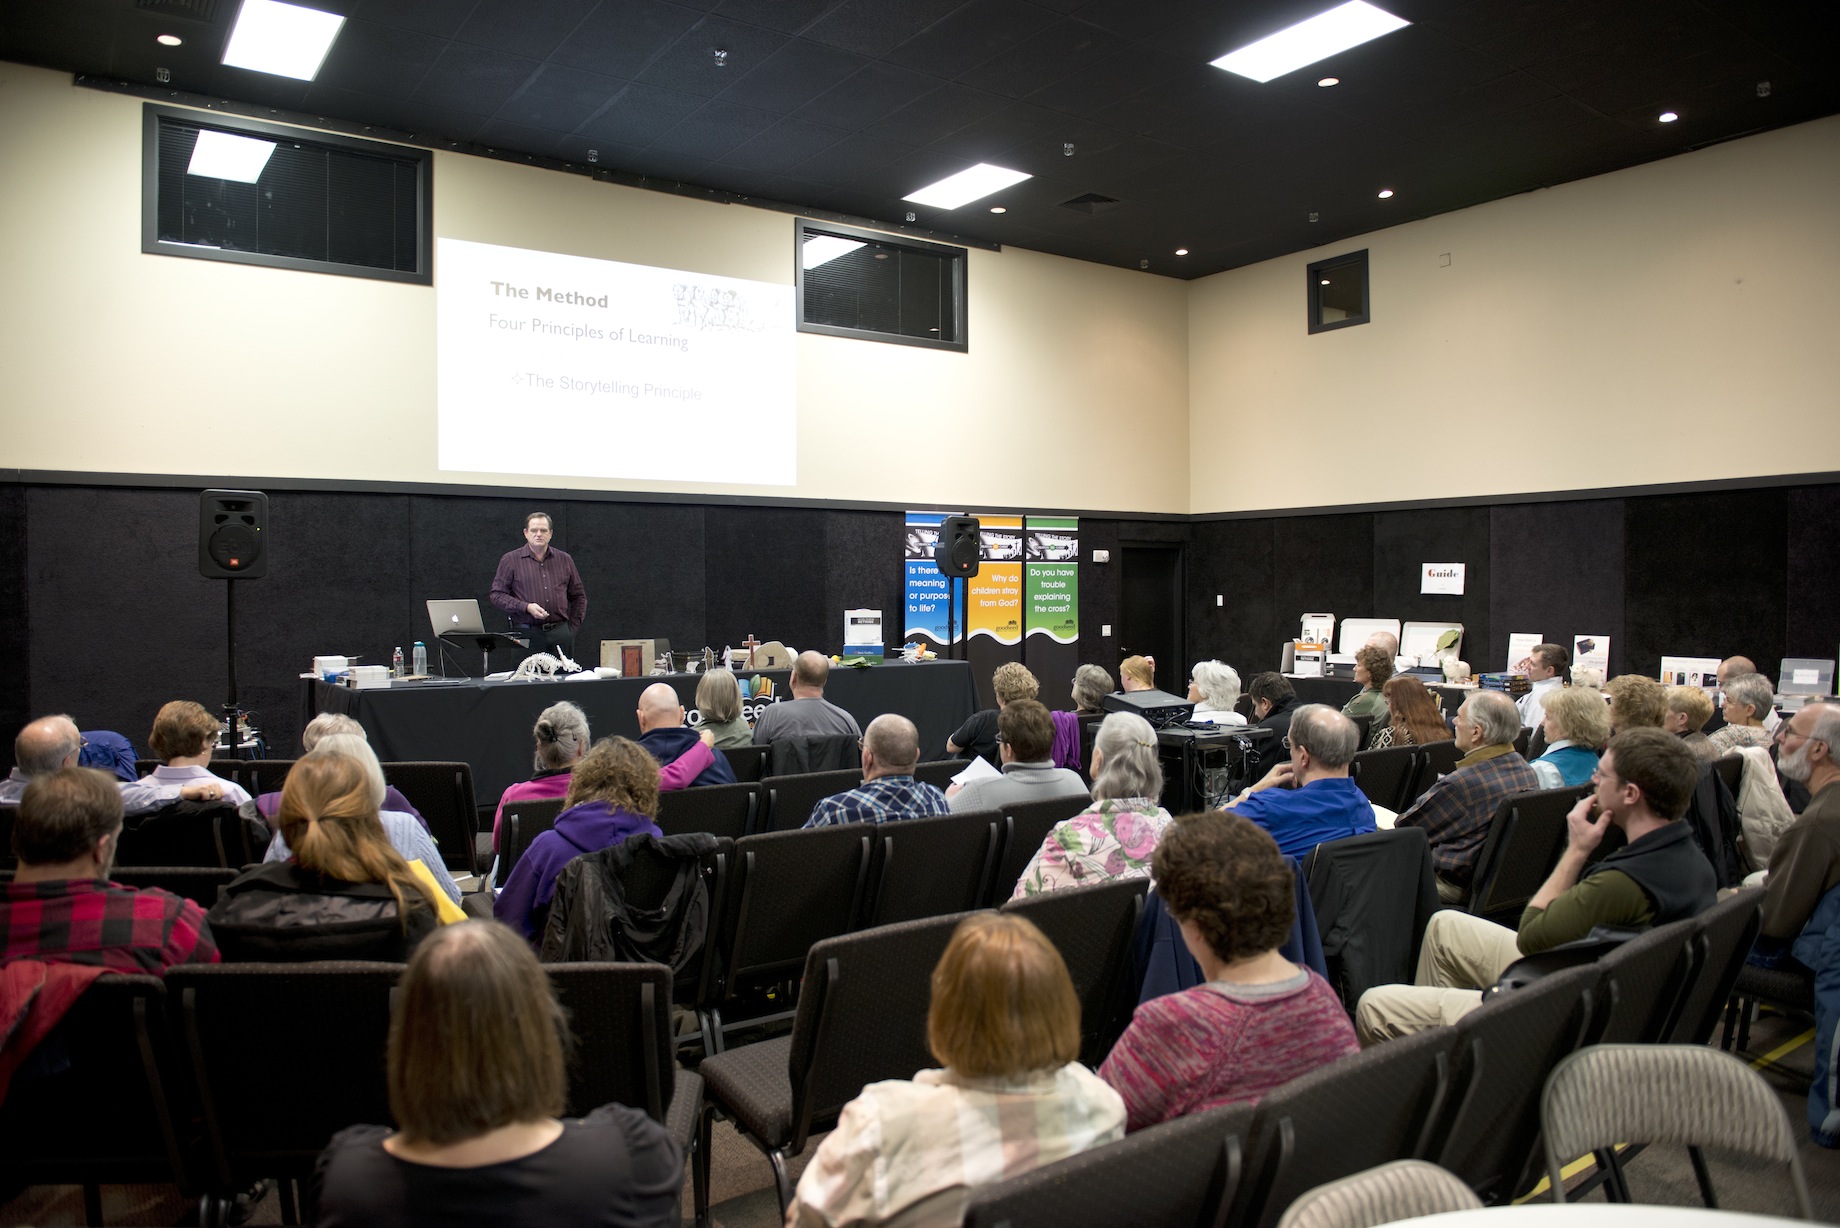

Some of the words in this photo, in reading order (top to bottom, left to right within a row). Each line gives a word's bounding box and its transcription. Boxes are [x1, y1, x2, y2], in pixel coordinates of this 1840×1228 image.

[490, 281, 529, 299] The
[536, 286, 608, 308] Method
[489, 313, 526, 331] Four
[531, 318, 604, 341] Principles
[609, 327, 624, 341] of
[629, 328, 688, 352] Learning
[525, 372, 554, 389] The
[559, 375, 639, 399] Storytelling
[644, 382, 702, 402] Principle
[909, 566, 916, 575] Is
[917, 566, 939, 575] there
[1042, 569, 1055, 577] you
[1056, 569, 1074, 577] have
[1427, 568, 1459, 578] Guide
[991, 574, 1007, 583] Why
[1008, 574, 1019, 582] do
[909, 580, 946, 589] meaning
[1041, 580, 1066, 589] trouble
[971, 586, 1001, 595] children
[1002, 587, 1019, 595] stray
[1033, 592, 1071, 602] explaining
[980, 599, 997, 607] from
[998, 599, 1019, 607] God?
[909, 604, 917, 612] to
[919, 604, 936, 612] life?
[1034, 604, 1047, 613] the
[1048, 604, 1070, 613] cross?
[995, 624, 1019, 632] goodseed
